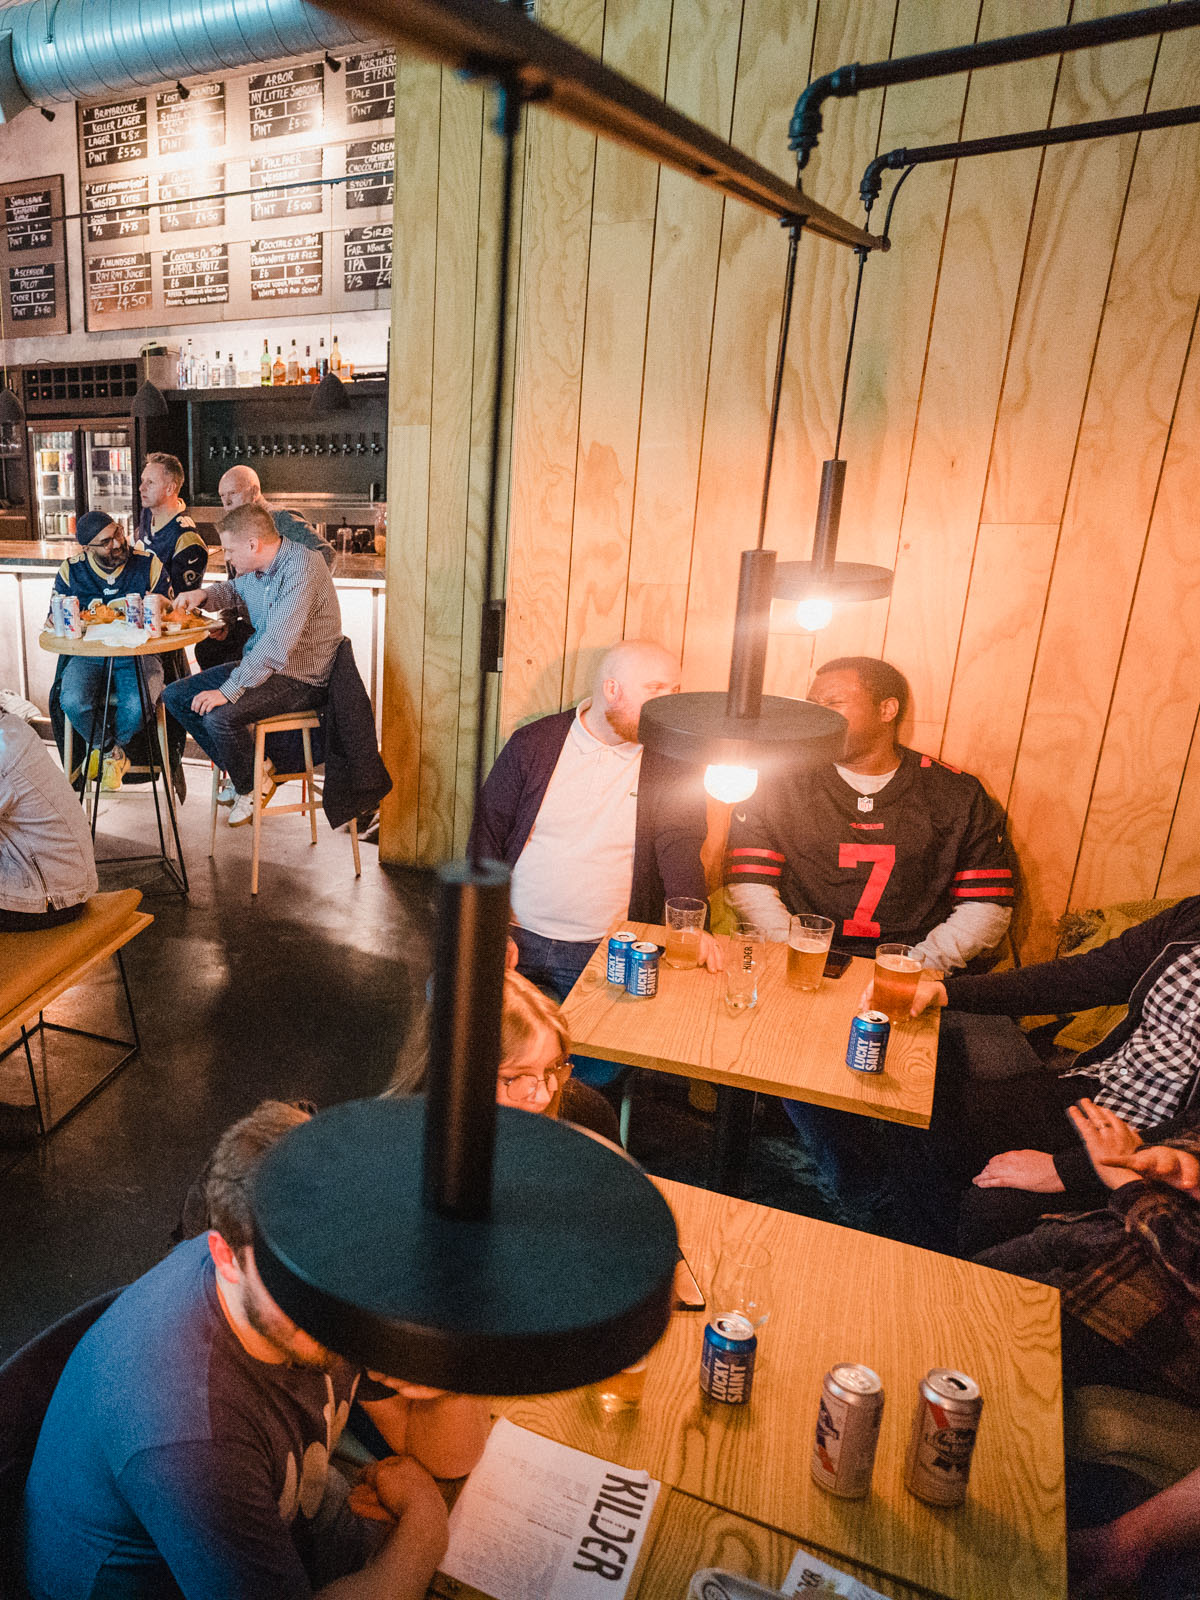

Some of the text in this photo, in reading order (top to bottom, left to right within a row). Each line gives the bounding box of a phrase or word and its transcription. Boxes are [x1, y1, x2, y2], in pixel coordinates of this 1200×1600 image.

[264, 70, 294, 87] ARBOR
[363, 67, 397, 83] ETERN
[163, 93, 180, 104] LOST
[251, 91, 262, 105] MY
[263, 87, 289, 102] LITTLE
[351, 89, 371, 100] PALE
[94, 103, 138, 119] BRAYBROOKE
[254, 107, 274, 119] PALE
[351, 105, 373, 119] PINT
[92, 115, 142, 134] KELLER LAGER
[253, 123, 272, 136] PINT
[88, 135, 111, 147] LAGER
[370, 142, 395, 154] SIREN
[88, 152, 107, 164] PINT
[348, 160, 387, 173] CHOCOLATE
[91, 184, 107, 195] LEFT
[350, 179, 374, 188] STOUT
[90, 197, 118, 209] TWISTED
[254, 202, 276, 217] PINT
[258, 237, 293, 251] COCKTAILS
[346, 244, 365, 257] FAR
[100, 256, 137, 269] AMUNDSEN
[170, 249, 200, 263] COCKTAILS
[169, 260, 220, 276] APEROL SPRITZ
[348, 258, 367, 272] IPA
[95, 268, 145, 283] RAY RAY JUICE
[20, 280, 39, 290] PILOT
[123, 282, 136, 293] 6%
[12, 293, 31, 303] CIDER
[116, 294, 147, 311] £4.50
[13, 307, 27, 317] PINT
[838, 842, 897, 938] 7
[607, 952, 617, 982] LUCKY
[615, 955, 627, 985] SAINT
[636, 966, 648, 996] LUCKY
[646, 968, 658, 996] SAINT
[853, 1037, 869, 1070] LUCKY
[865, 1040, 882, 1071] SAINT
[711, 1358, 730, 1401] LUCKY
[727, 1363, 747, 1404] SAINT
[572, 1472, 650, 1582] KILDER
